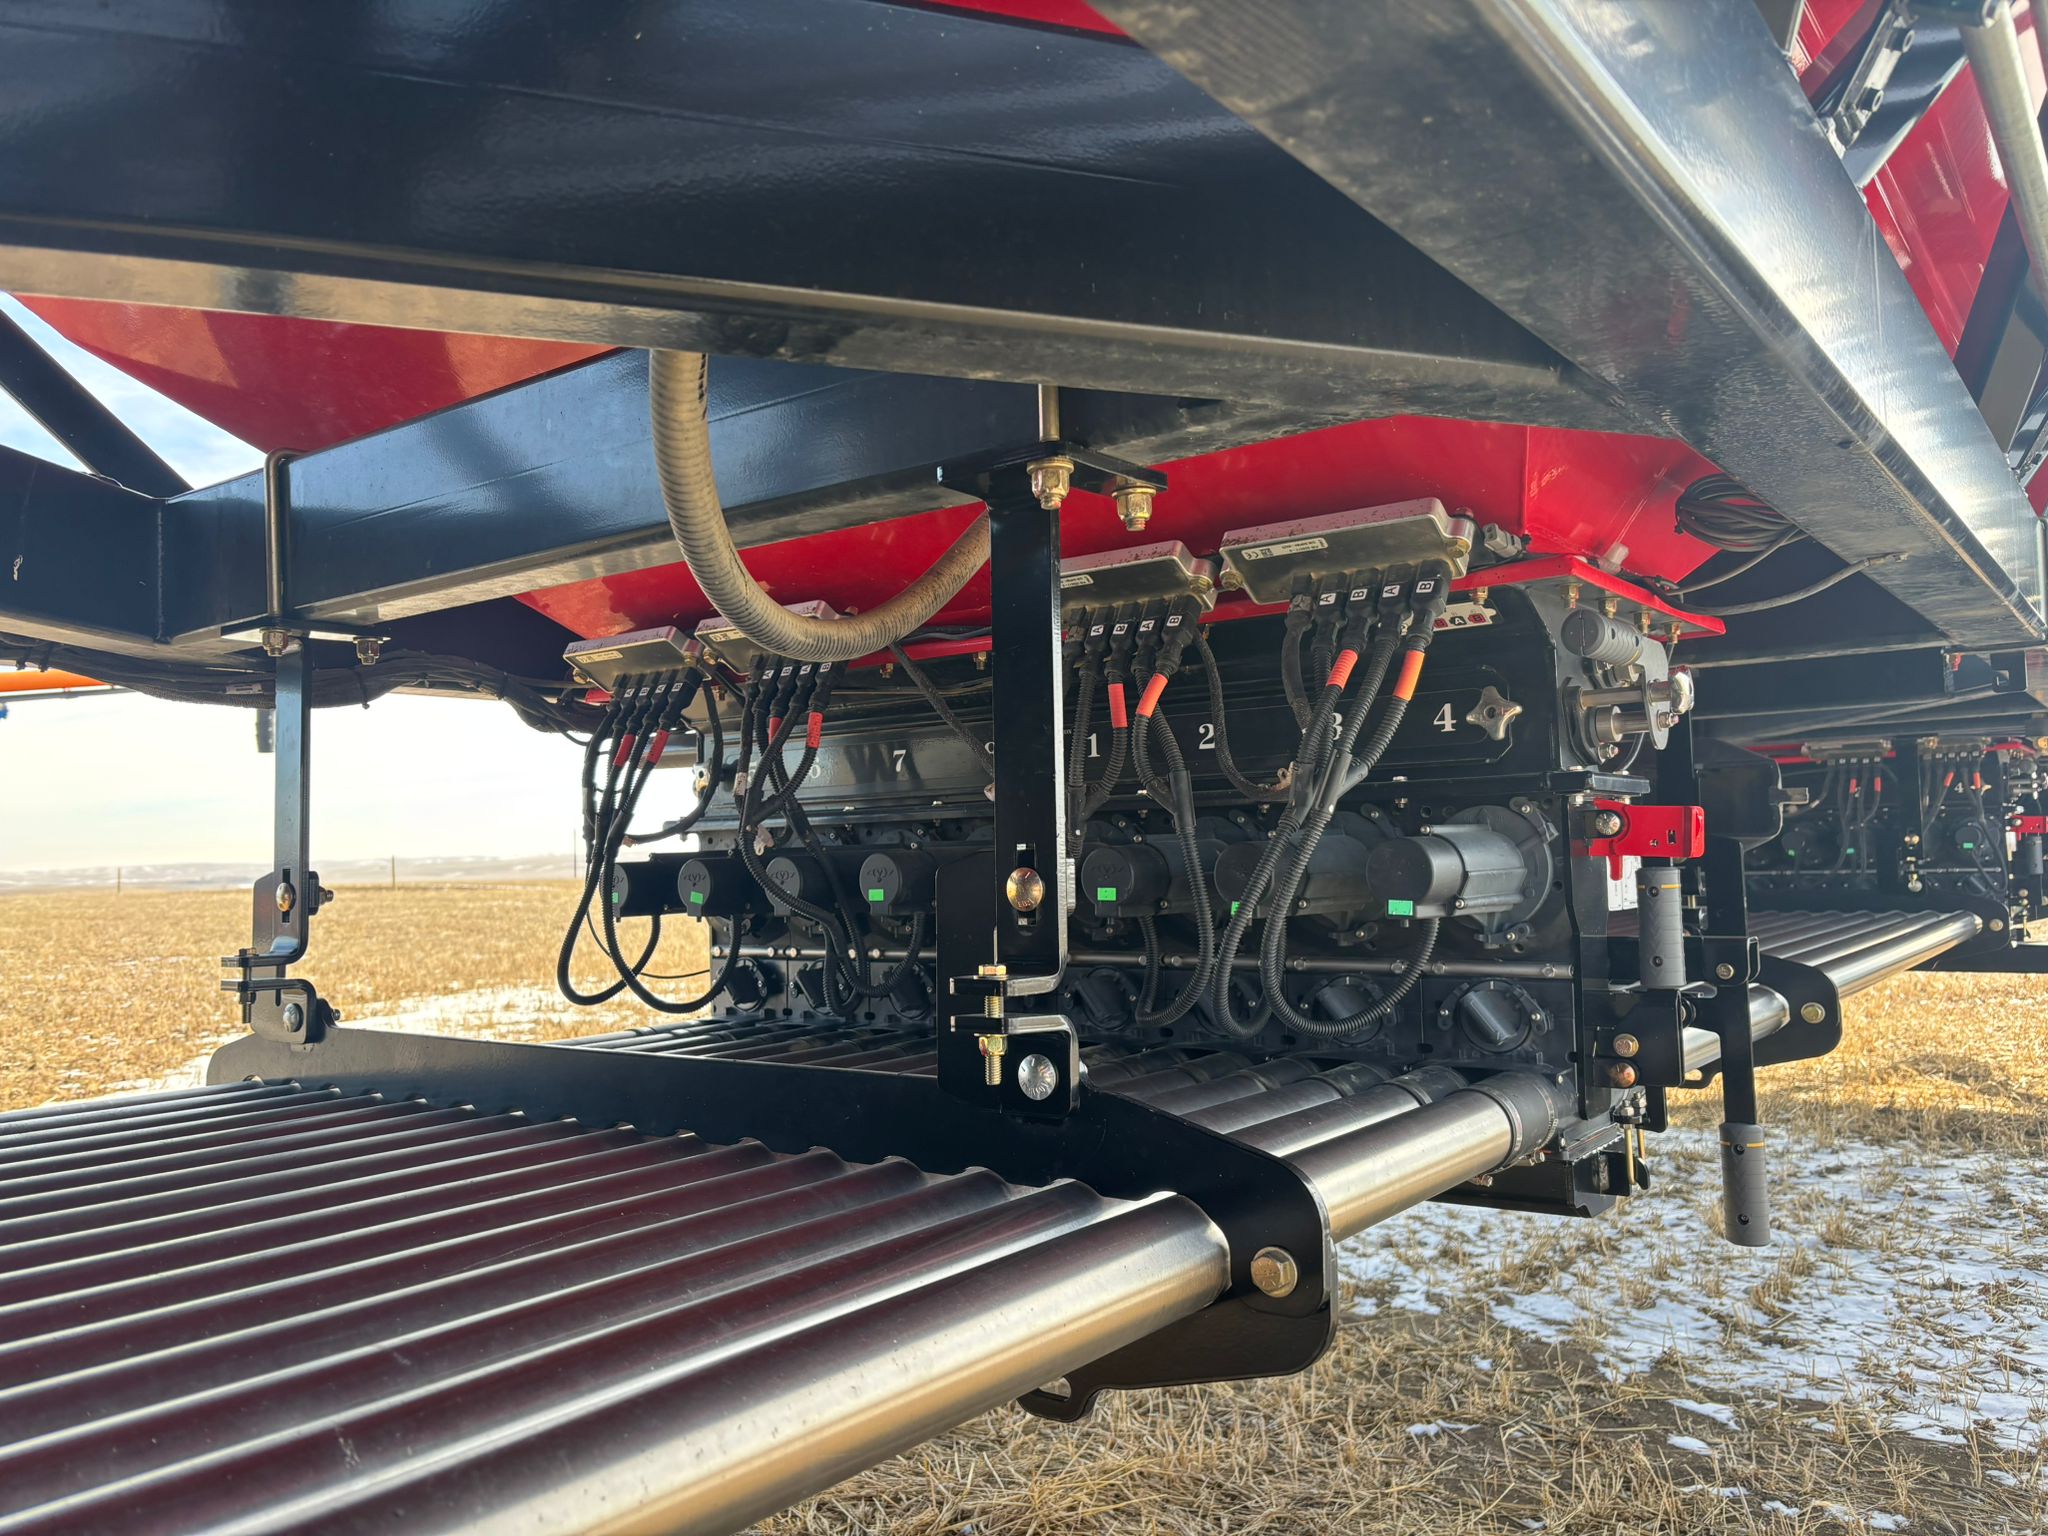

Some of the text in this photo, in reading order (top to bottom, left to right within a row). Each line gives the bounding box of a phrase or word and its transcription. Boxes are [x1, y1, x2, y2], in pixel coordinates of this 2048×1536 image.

[1385, 585, 1398, 596] A
[1420, 582, 1432, 592] B
[1322, 593, 1336, 604] A
[1352, 590, 1365, 599] B
[1141, 621, 1153, 630] A
[1169, 616, 1180, 624] B
[1454, 617, 1465, 625] A
[1092, 625, 1103, 635] A
[1115, 625, 1127, 633] B
[1433, 702, 1457, 732] 4
[1332, 712, 1343, 740] 3
[1198, 723, 1216, 750] 2
[1087, 732, 1100, 758] 1
[893, 750, 907, 773] 7
[1954, 782, 1965, 793] 4
